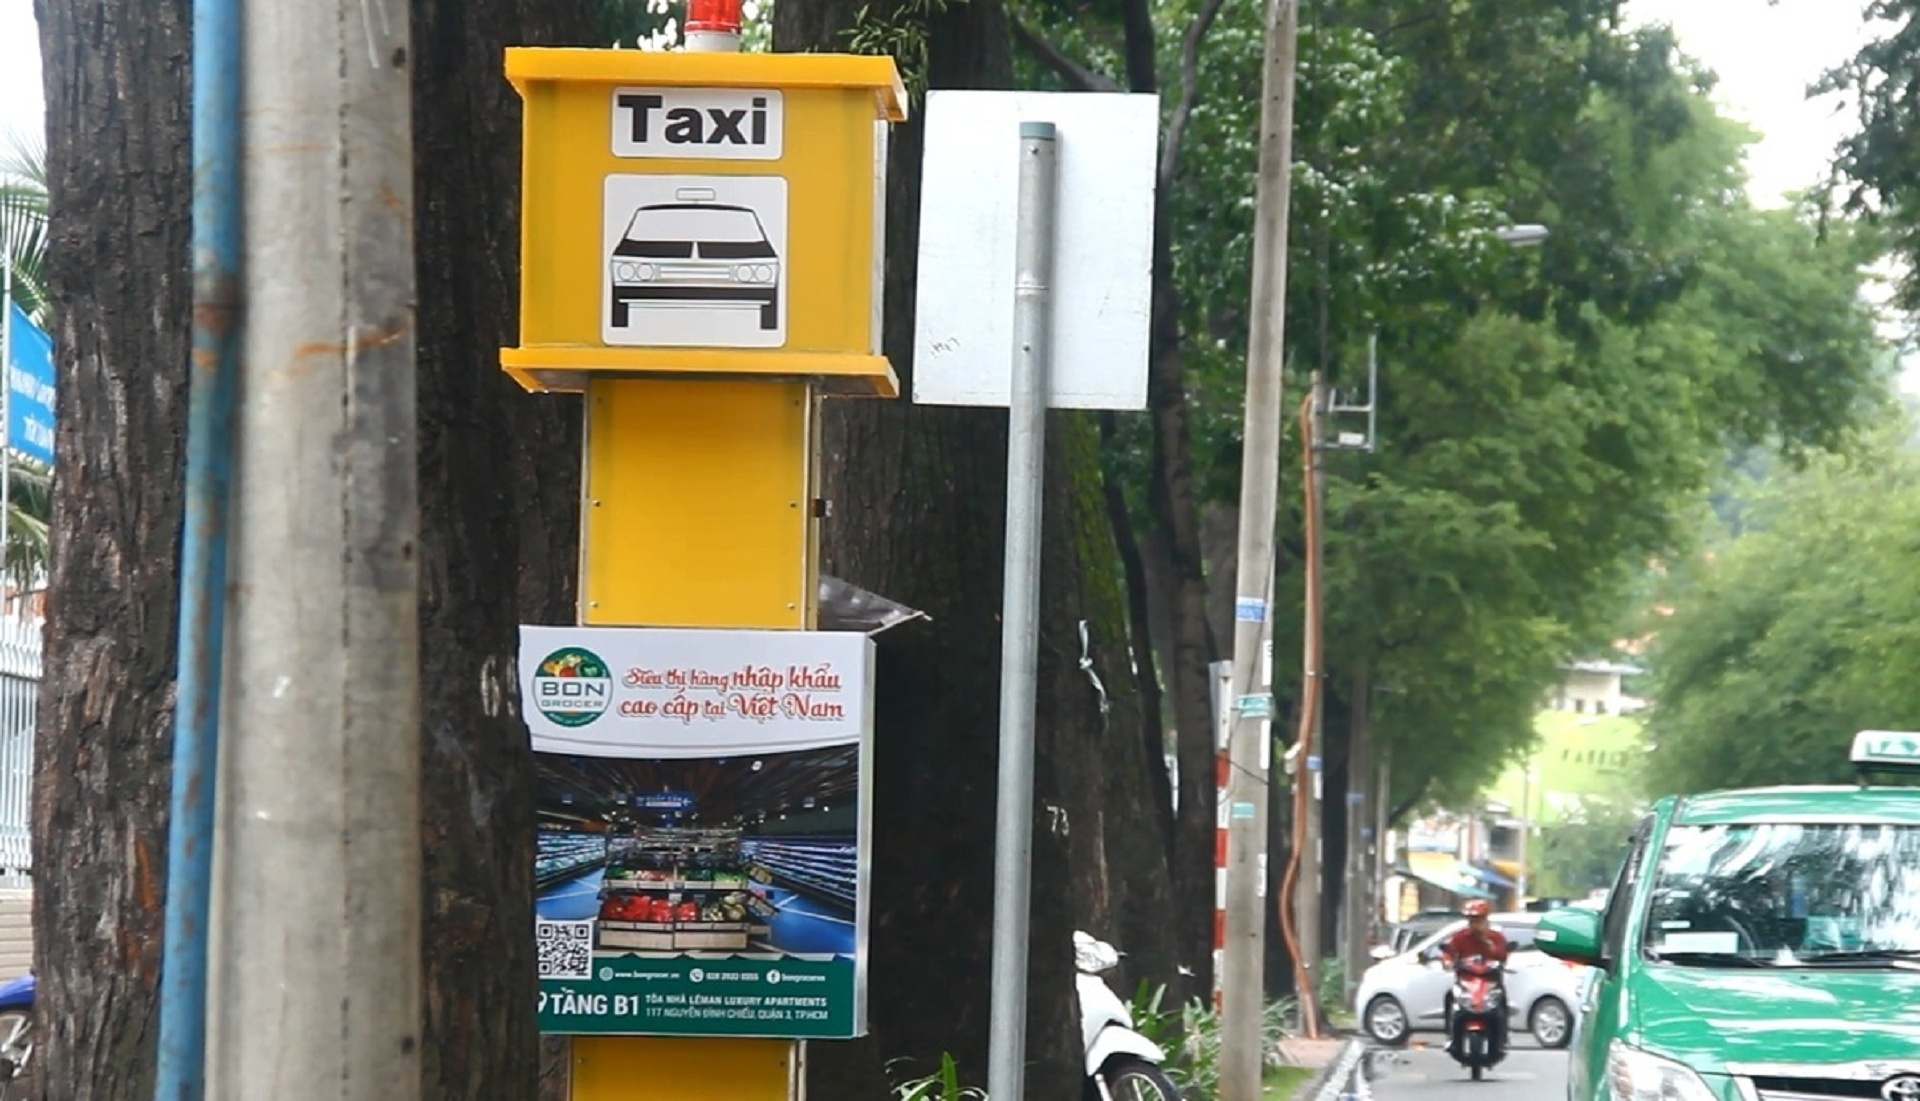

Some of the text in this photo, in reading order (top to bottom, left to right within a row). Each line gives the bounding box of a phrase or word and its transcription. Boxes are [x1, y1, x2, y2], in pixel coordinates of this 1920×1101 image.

[618, 94, 767, 145] Taxi
[690, 669, 729, 693] hàng
[733, 664, 784, 694] nhập
[787, 662, 842, 690] khẩu
[542, 682, 604, 697] BON
[541, 700, 602, 708] GROCER
[620, 700, 658, 715] cao
[662, 687, 699, 722] cấp
[728, 692, 779, 721] Việt
[781, 692, 845, 719] Nam
[550, 987, 638, 1016] TẦNG B1
[646, 1007, 661, 1017] 117
[724, 996, 761, 1006] LUXURY
[763, 996, 827, 1007] APARTMENTS
